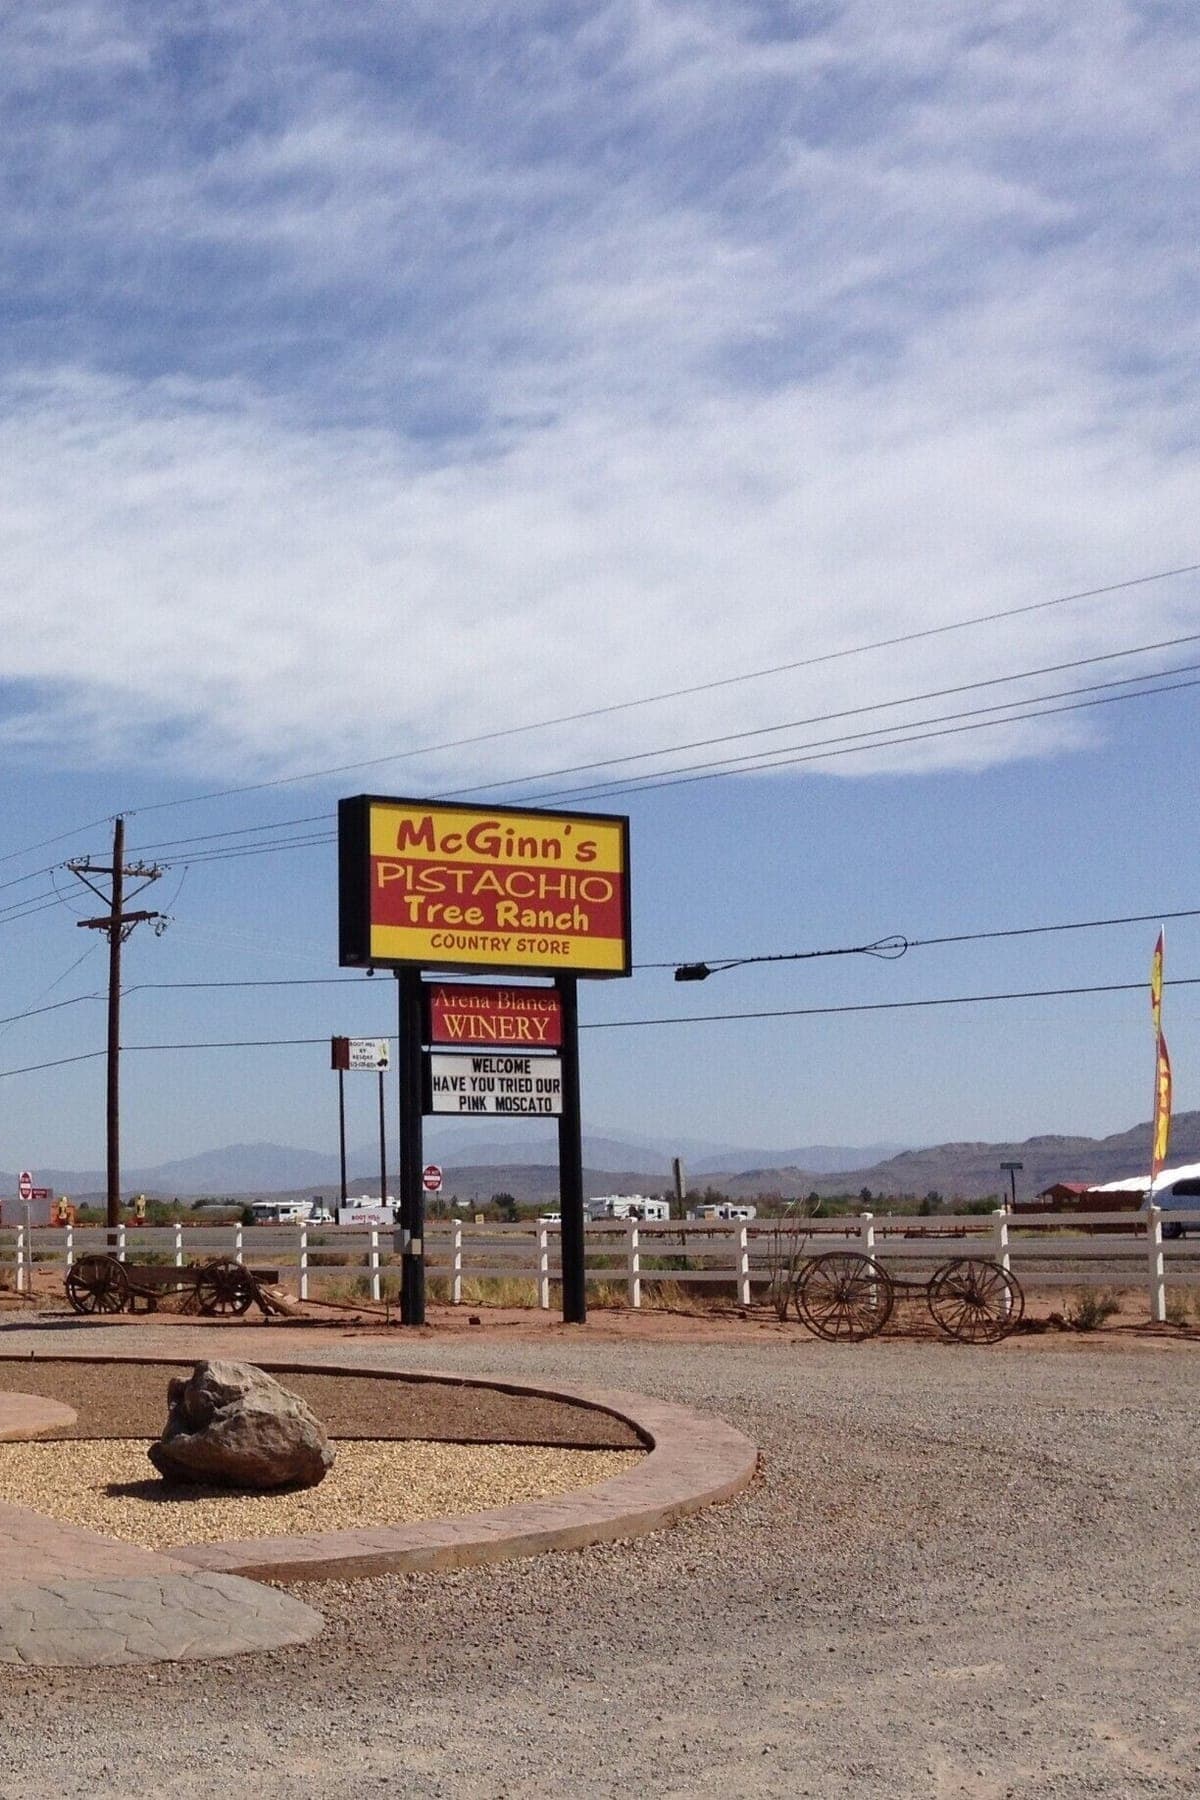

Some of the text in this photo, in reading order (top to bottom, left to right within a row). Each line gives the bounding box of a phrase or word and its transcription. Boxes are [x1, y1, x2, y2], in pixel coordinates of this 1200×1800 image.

[396, 816, 598, 862] McGinn's
[377, 862, 613, 903] PISTACHIO
[403, 894, 589, 932] Tree Ranch
[430, 933, 570, 955] COUNTRY STORE
[434, 988, 559, 1012] Arena Blanca
[442, 1013, 550, 1040] WINERY
[472, 1058, 531, 1074] WELCOME
[433, 1076, 560, 1093] HAVE YOU TRIED OUR
[459, 1096, 552, 1112] PINK MOSCATO
